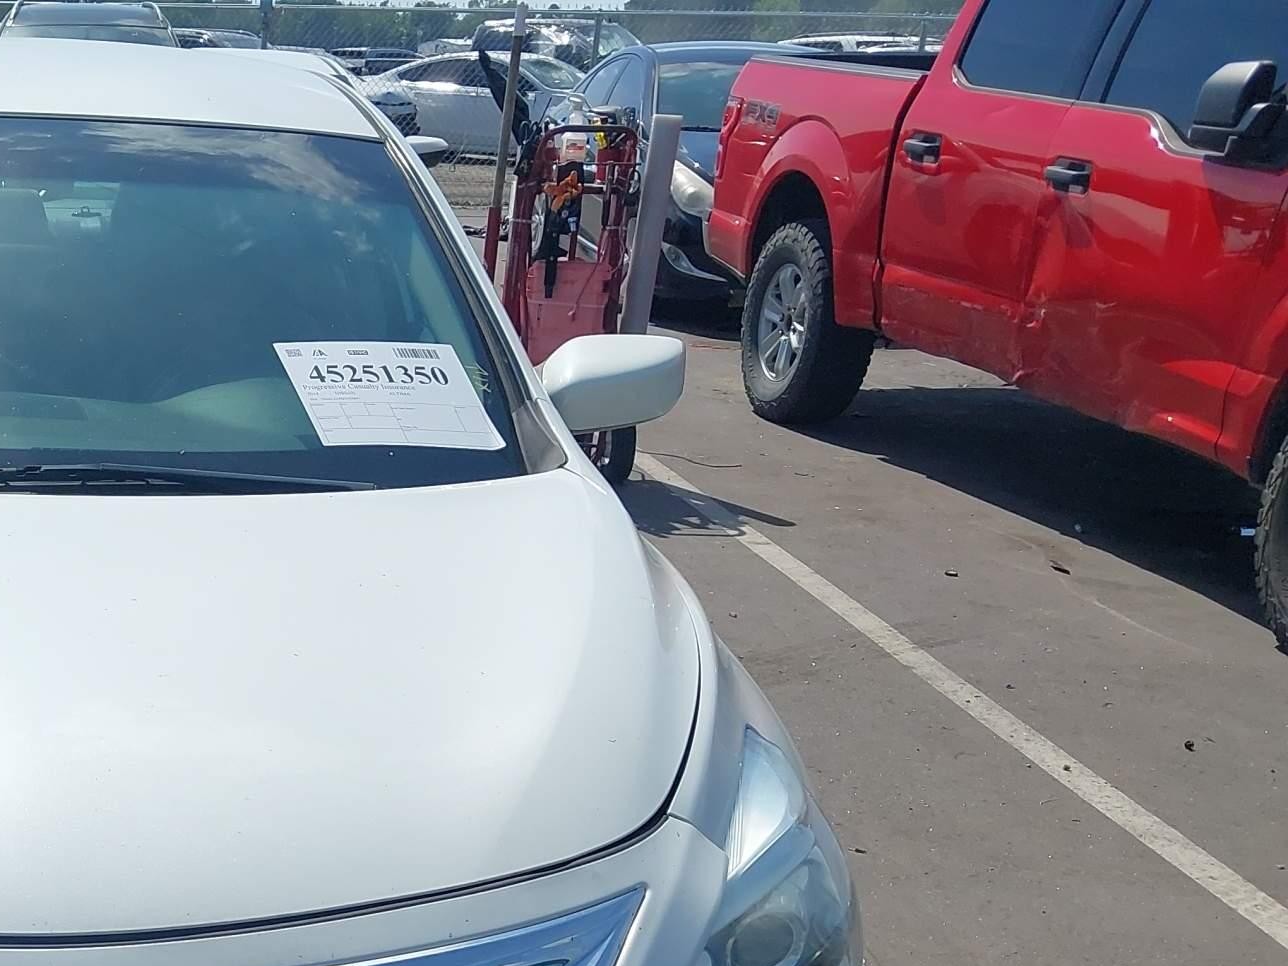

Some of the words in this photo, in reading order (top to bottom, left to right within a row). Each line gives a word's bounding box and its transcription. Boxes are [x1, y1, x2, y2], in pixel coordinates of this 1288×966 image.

[309, 364, 449, 386] 45251350
[302, 383, 346, 392] Progressive
[347, 383, 379, 392] Casualty
